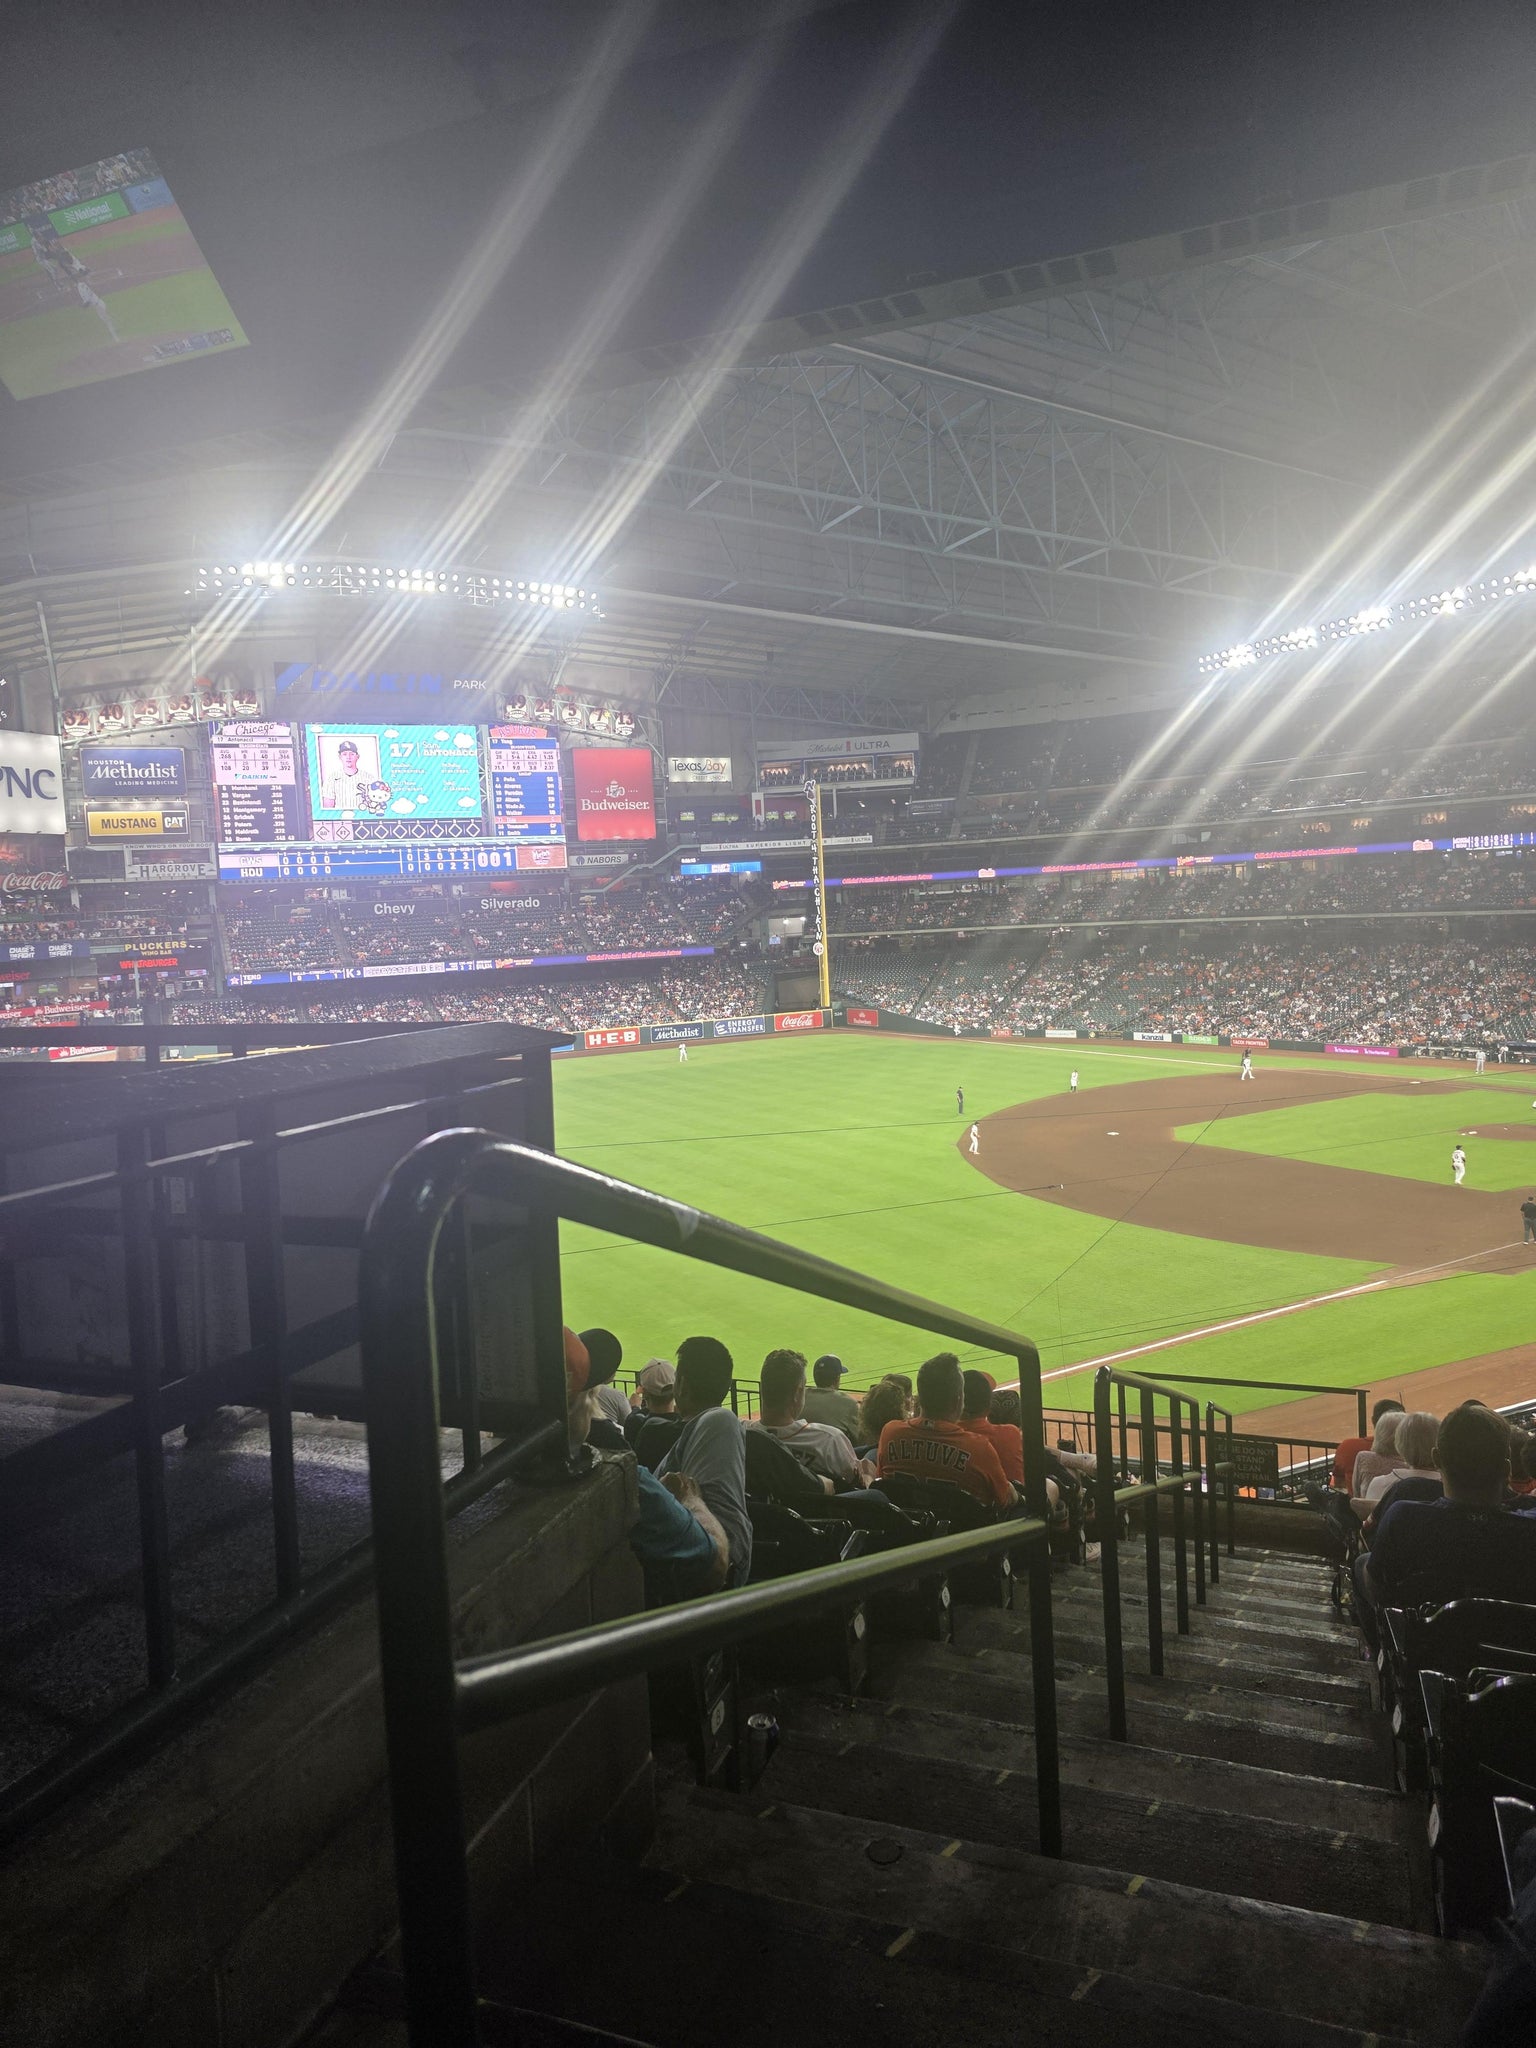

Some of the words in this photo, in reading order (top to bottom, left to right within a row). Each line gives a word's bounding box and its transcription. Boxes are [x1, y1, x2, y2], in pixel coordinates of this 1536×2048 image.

[311, 671, 442, 693] DAIKIN
[453, 680, 487, 689] PARK
[235, 724, 275, 736] Chicago
[389, 742, 415, 757] 17
[854, 740, 890, 751] ULTRA
[90, 763, 179, 778] Methodist
[672, 759, 702, 771] Texas
[702, 759, 726, 774] Bay
[101, 818, 157, 829] MUSTANG
[164, 816, 185, 828] CAT
[140, 864, 206, 877] HARGROVE
[240, 868, 263, 877] HOU
[2, 871, 64, 892] Coca-Cola
[374, 902, 416, 916] Chevy
[480, 897, 540, 910] Silverado
[124, 941, 187, 951] PLUCKERS
[346, 968, 355, 978] K
[44, 1004, 91, 1014] Budweiser
[728, 1019, 756, 1027] ENERGY
[782, 1014, 814, 1028] Coca-Cola
[655, 1027, 700, 1040] Methodist
[728, 1025, 764, 1033] TRANSFER
[887, 1438, 971, 1472] ALTUVE
[1236, 1455, 1265, 1464] STAND
